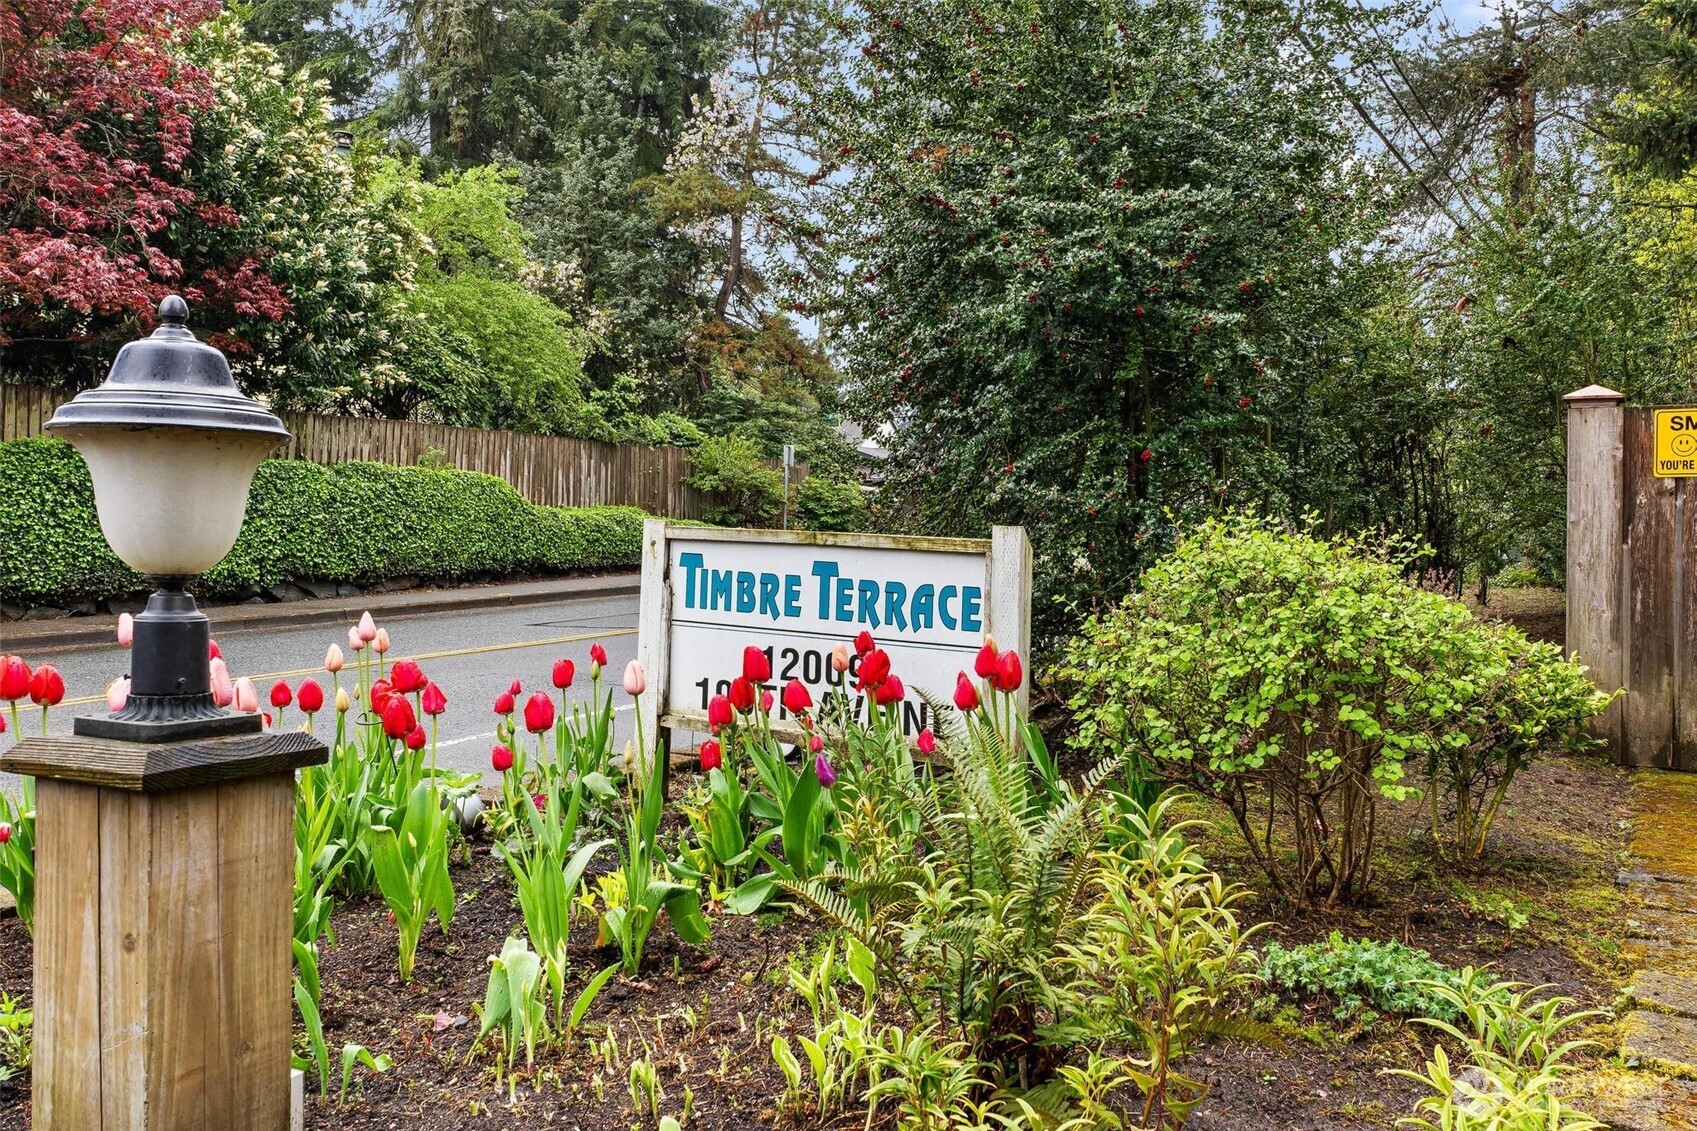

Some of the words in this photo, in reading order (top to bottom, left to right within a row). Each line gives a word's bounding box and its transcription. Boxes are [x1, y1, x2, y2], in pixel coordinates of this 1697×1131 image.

[1660, 460, 1695, 471] YOU'RE
[679, 552, 802, 621] TIMBRE
[811, 560, 982, 633] TERRACE
